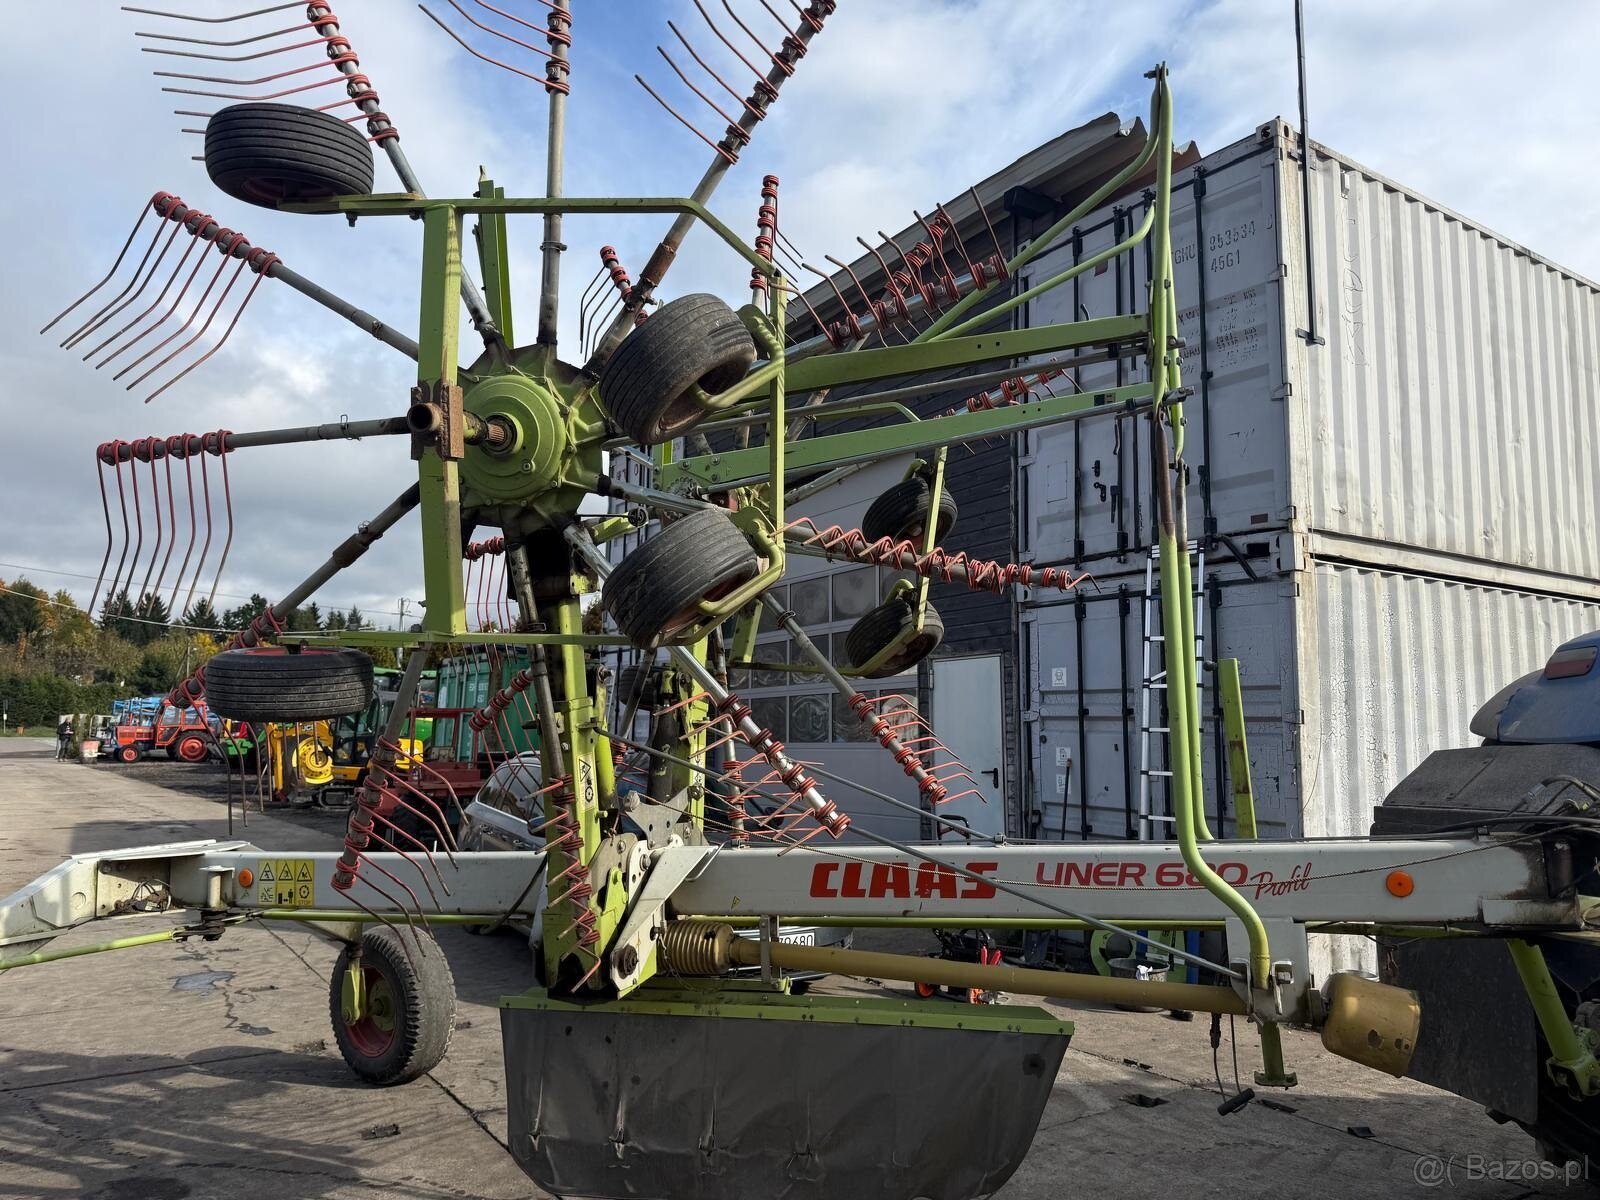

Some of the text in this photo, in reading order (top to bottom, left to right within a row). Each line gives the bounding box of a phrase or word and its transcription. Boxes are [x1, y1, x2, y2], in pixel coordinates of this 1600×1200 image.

[1172, 243, 1196, 265] GHU
[1210, 248, 1240, 273] 45G1
[809, 862, 999, 899] CLAAS
[1035, 862, 1312, 900] LINER 680 Profil
